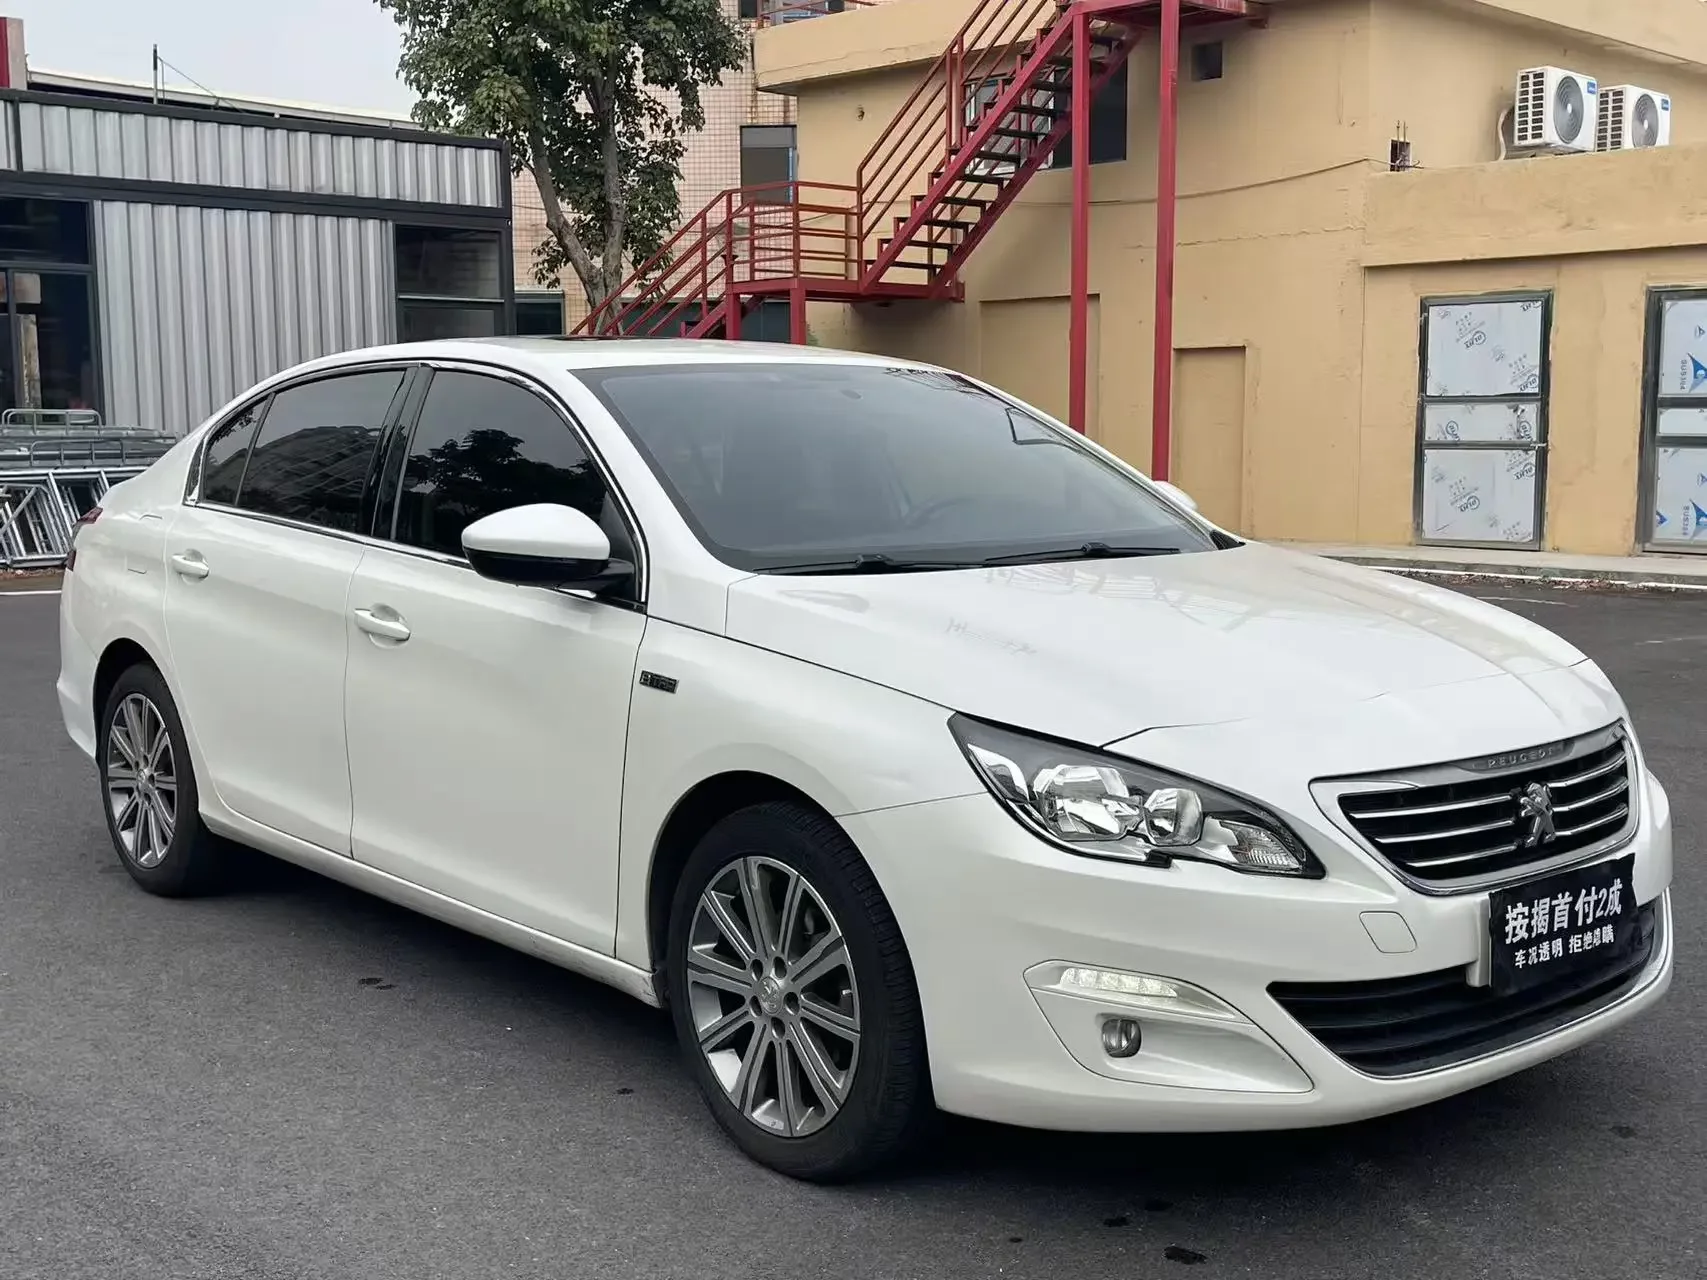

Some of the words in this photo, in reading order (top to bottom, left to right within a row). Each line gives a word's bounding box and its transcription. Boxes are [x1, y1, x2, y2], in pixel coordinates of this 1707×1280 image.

[1505, 878, 1623, 945] 按揭首付2成
[1515, 938, 1563, 969] 车况透明
